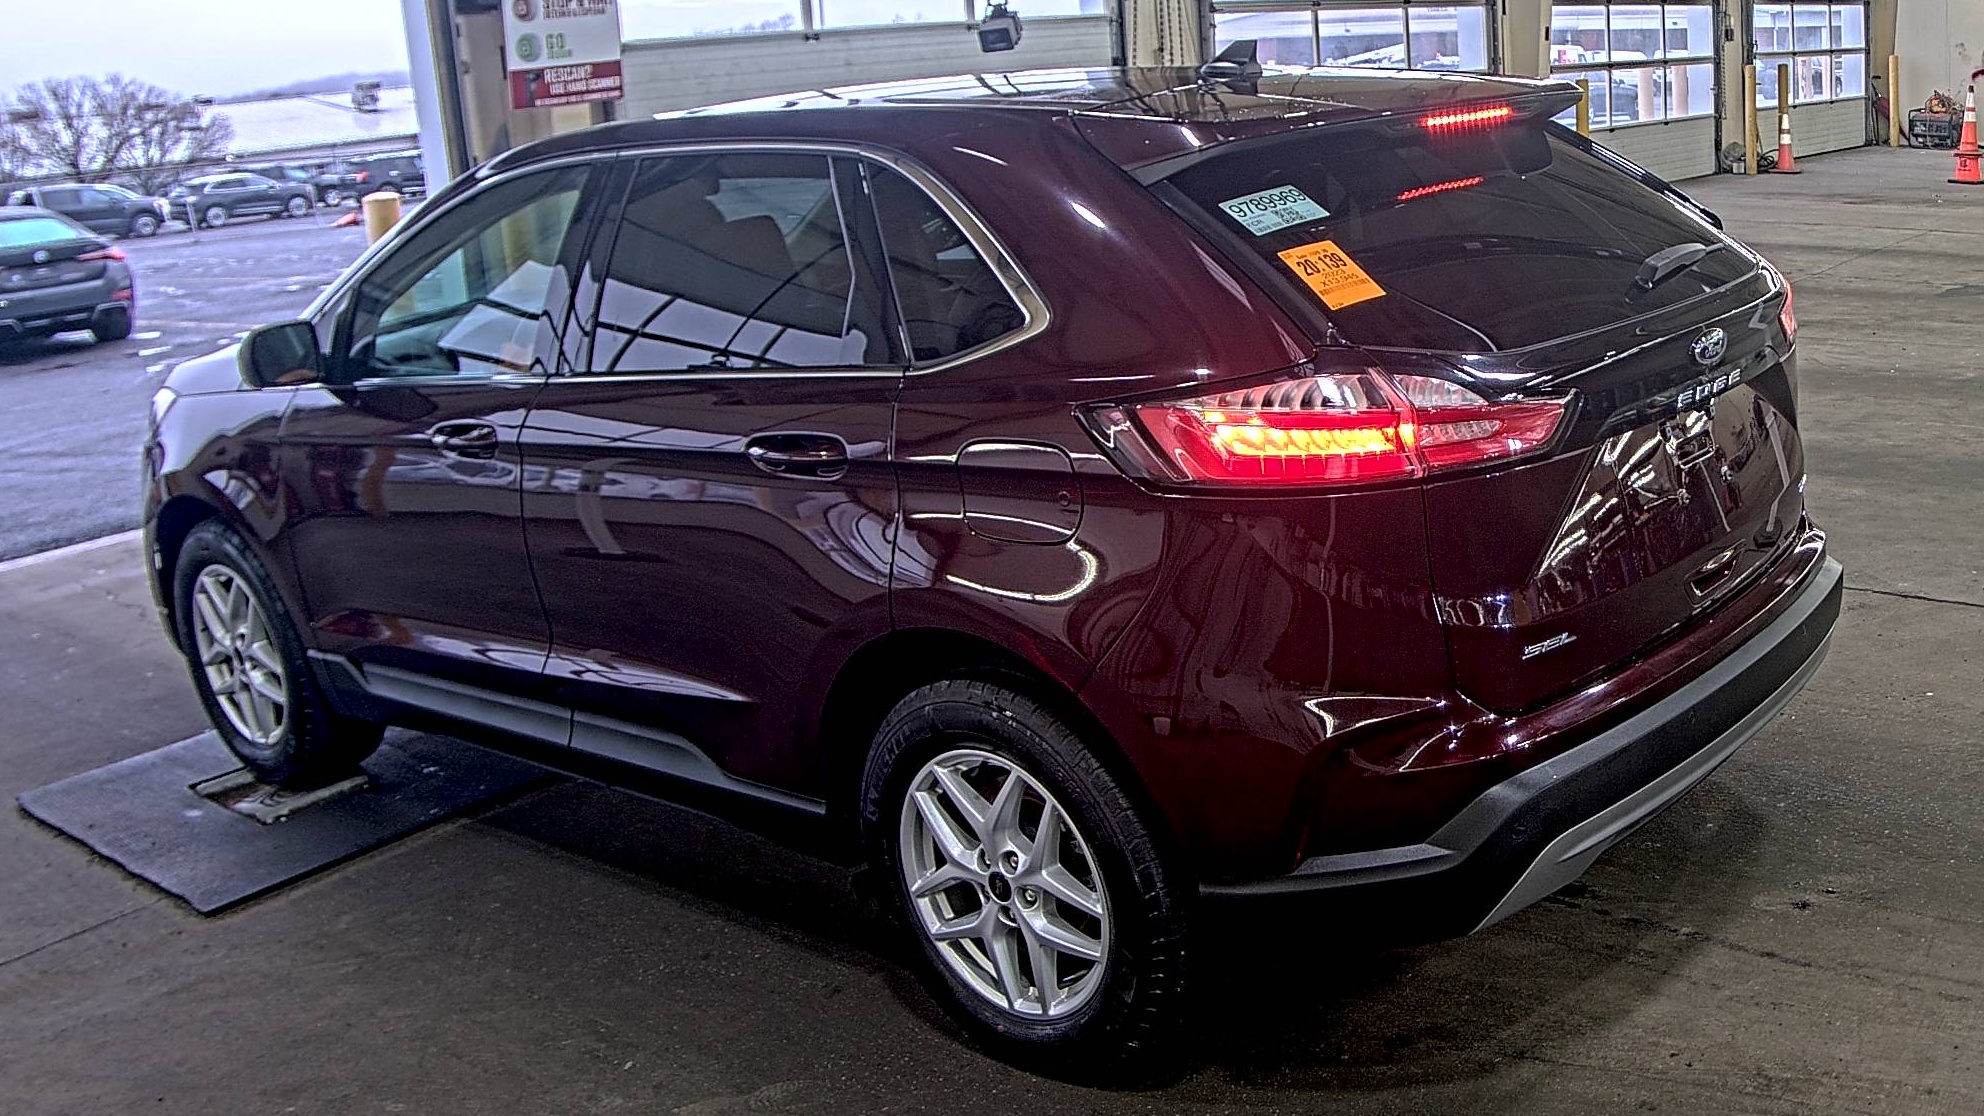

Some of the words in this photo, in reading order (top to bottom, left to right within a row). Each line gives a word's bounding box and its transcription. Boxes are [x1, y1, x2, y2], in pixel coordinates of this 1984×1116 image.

[546, 33, 564, 50] GO
[1228, 189, 1306, 218] 9789969
[1677, 368, 1741, 408] EDGE
[1521, 632, 1577, 660] SEL
